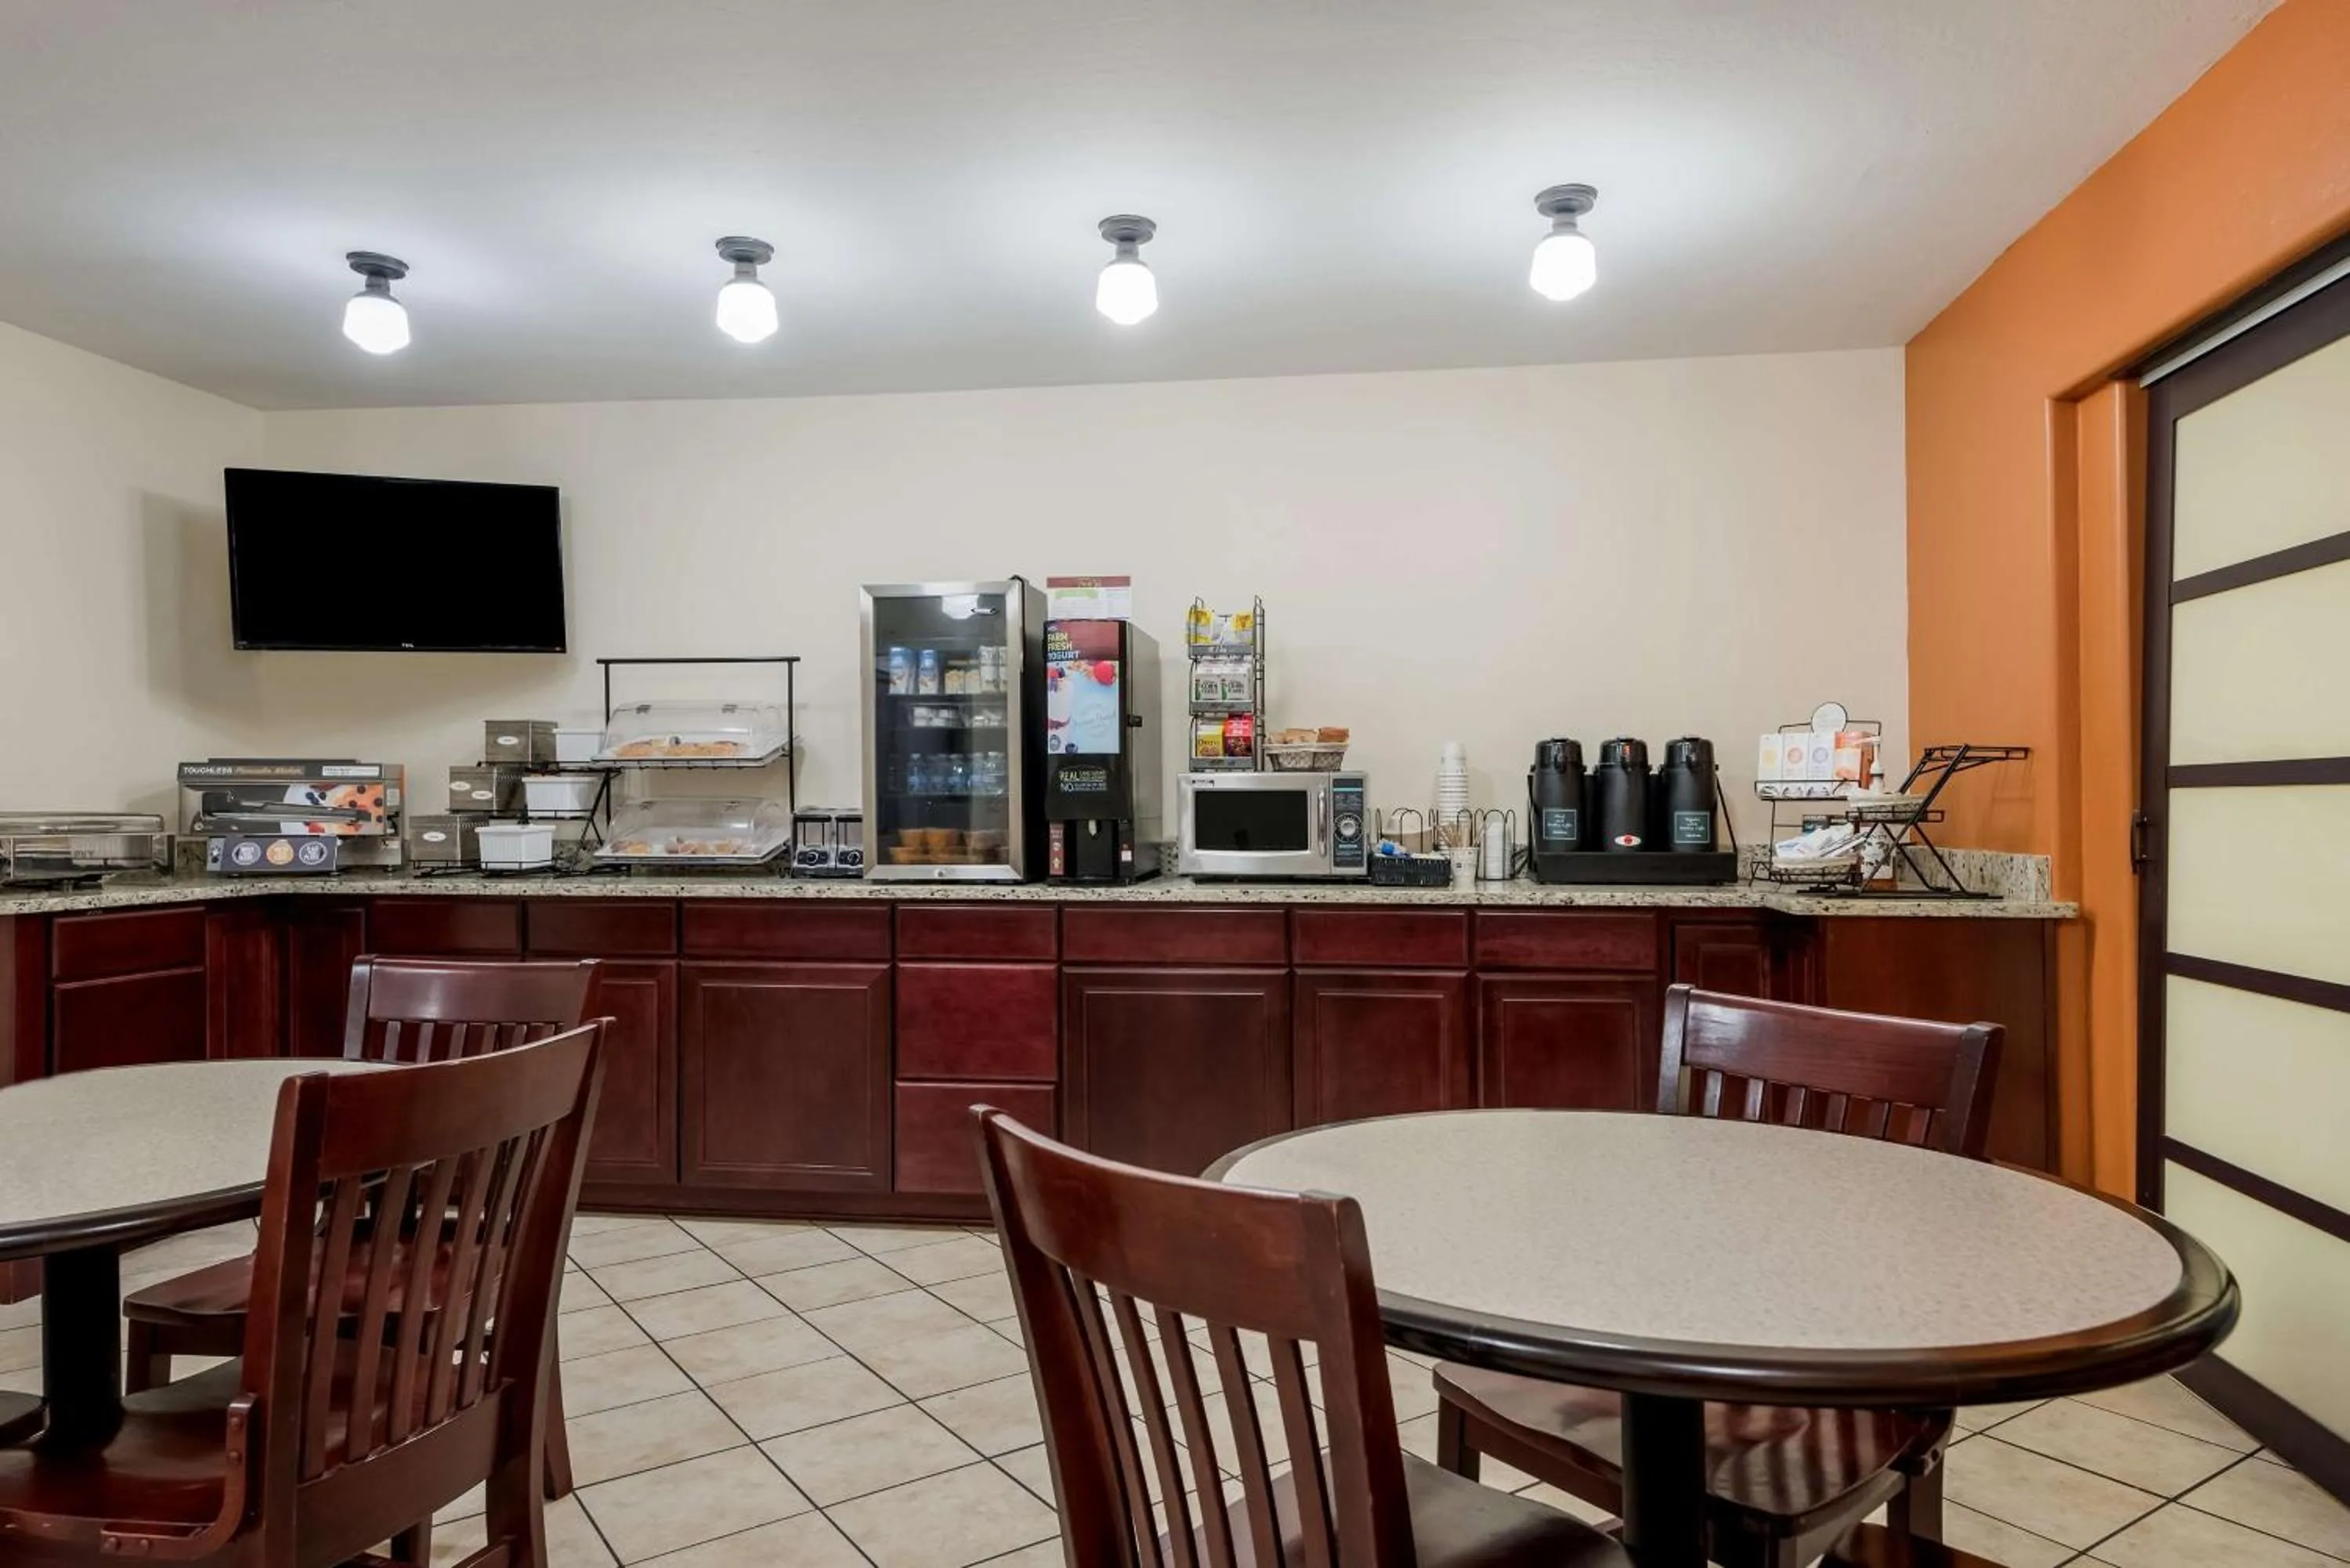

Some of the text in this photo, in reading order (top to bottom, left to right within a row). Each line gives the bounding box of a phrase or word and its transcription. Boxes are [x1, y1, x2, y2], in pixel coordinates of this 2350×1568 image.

[1048, 633, 1068, 642] FARM
[1048, 641, 1072, 652] FRESH
[1047, 651, 1079, 660] YOGURT
[183, 766, 233, 775] TOUCHLESS
